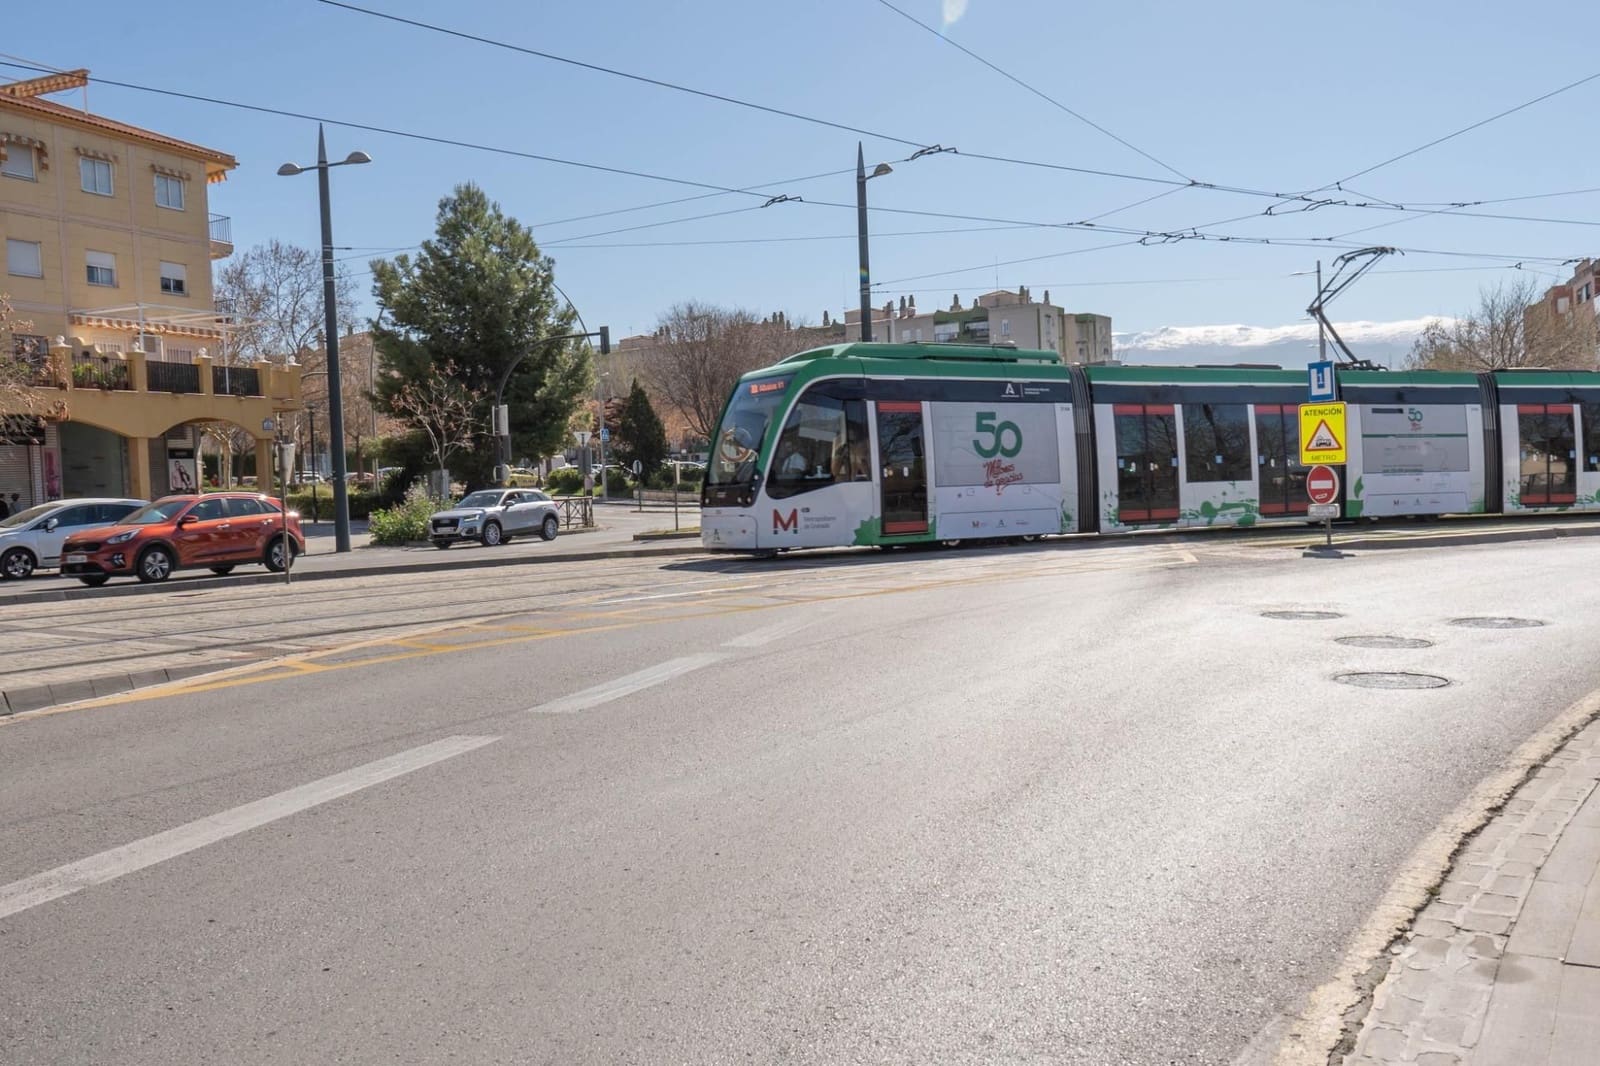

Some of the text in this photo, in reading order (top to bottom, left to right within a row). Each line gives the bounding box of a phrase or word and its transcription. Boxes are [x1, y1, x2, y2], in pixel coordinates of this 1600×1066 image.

[1304, 407, 1342, 417] ATENCIÓN
[1408, 408, 1423, 422] 50
[973, 412, 1023, 458] 50
[1311, 454, 1337, 462] METRO
[773, 508, 798, 534] M
